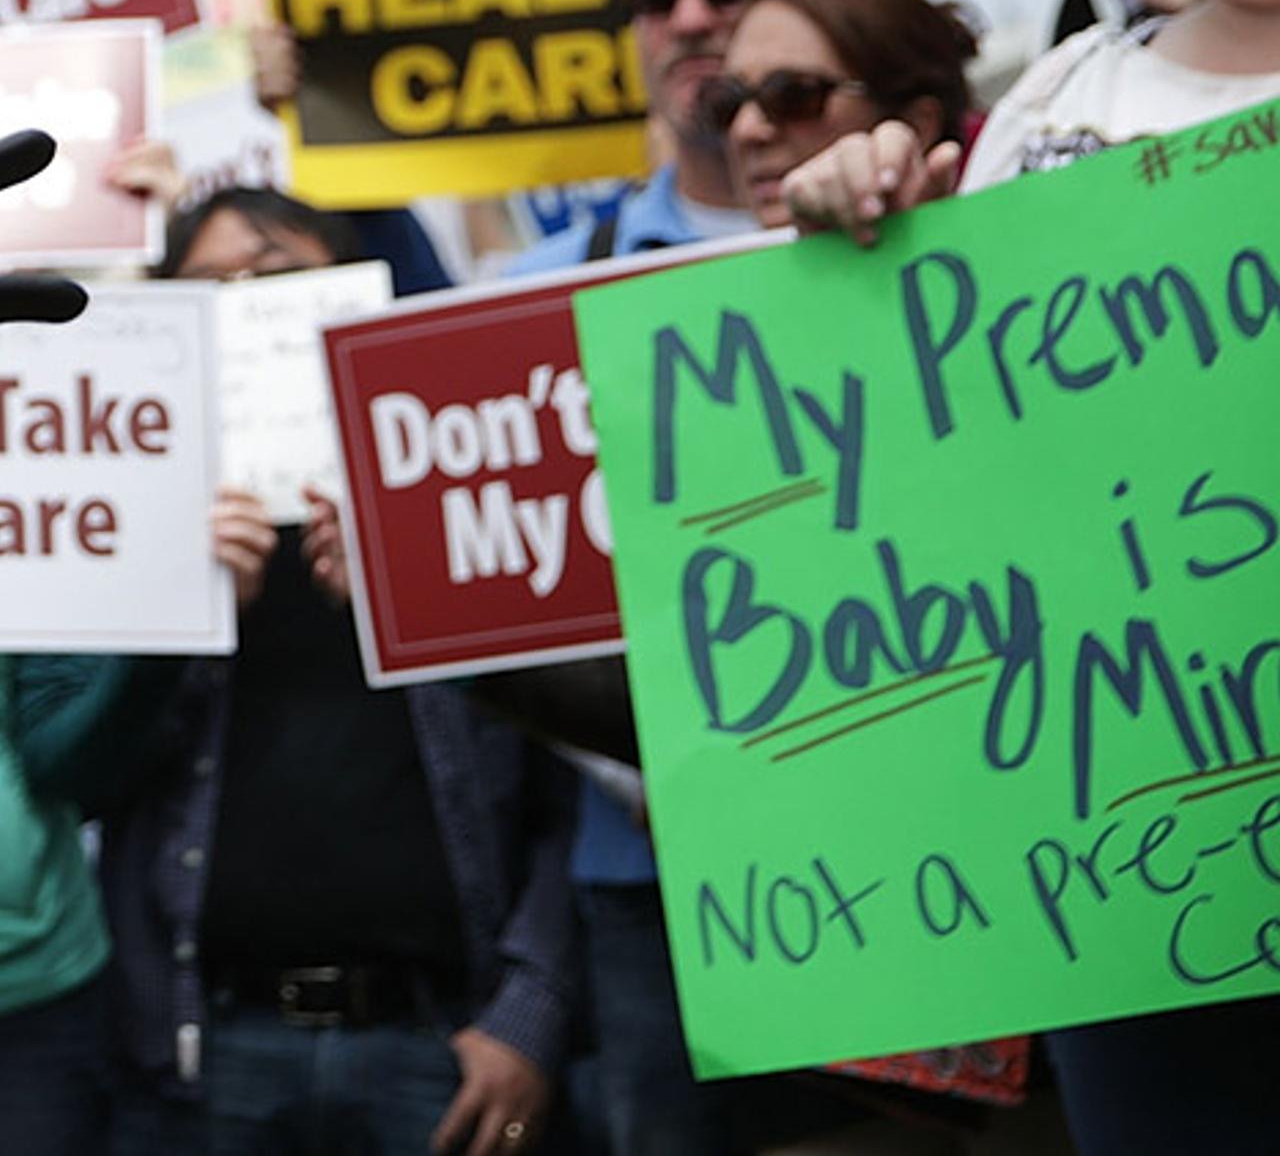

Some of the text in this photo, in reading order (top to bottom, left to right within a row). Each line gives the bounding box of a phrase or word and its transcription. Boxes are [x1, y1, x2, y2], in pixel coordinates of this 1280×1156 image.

[369, 365, 598, 489] Don't
[651, 308, 864, 531] My
[900, 247, 1280, 441] Prema
[442, 480, 568, 596] My
[1112, 470, 1278, 591] is
[681, 536, 1042, 770] Baby
[915, 854, 988, 936] a
